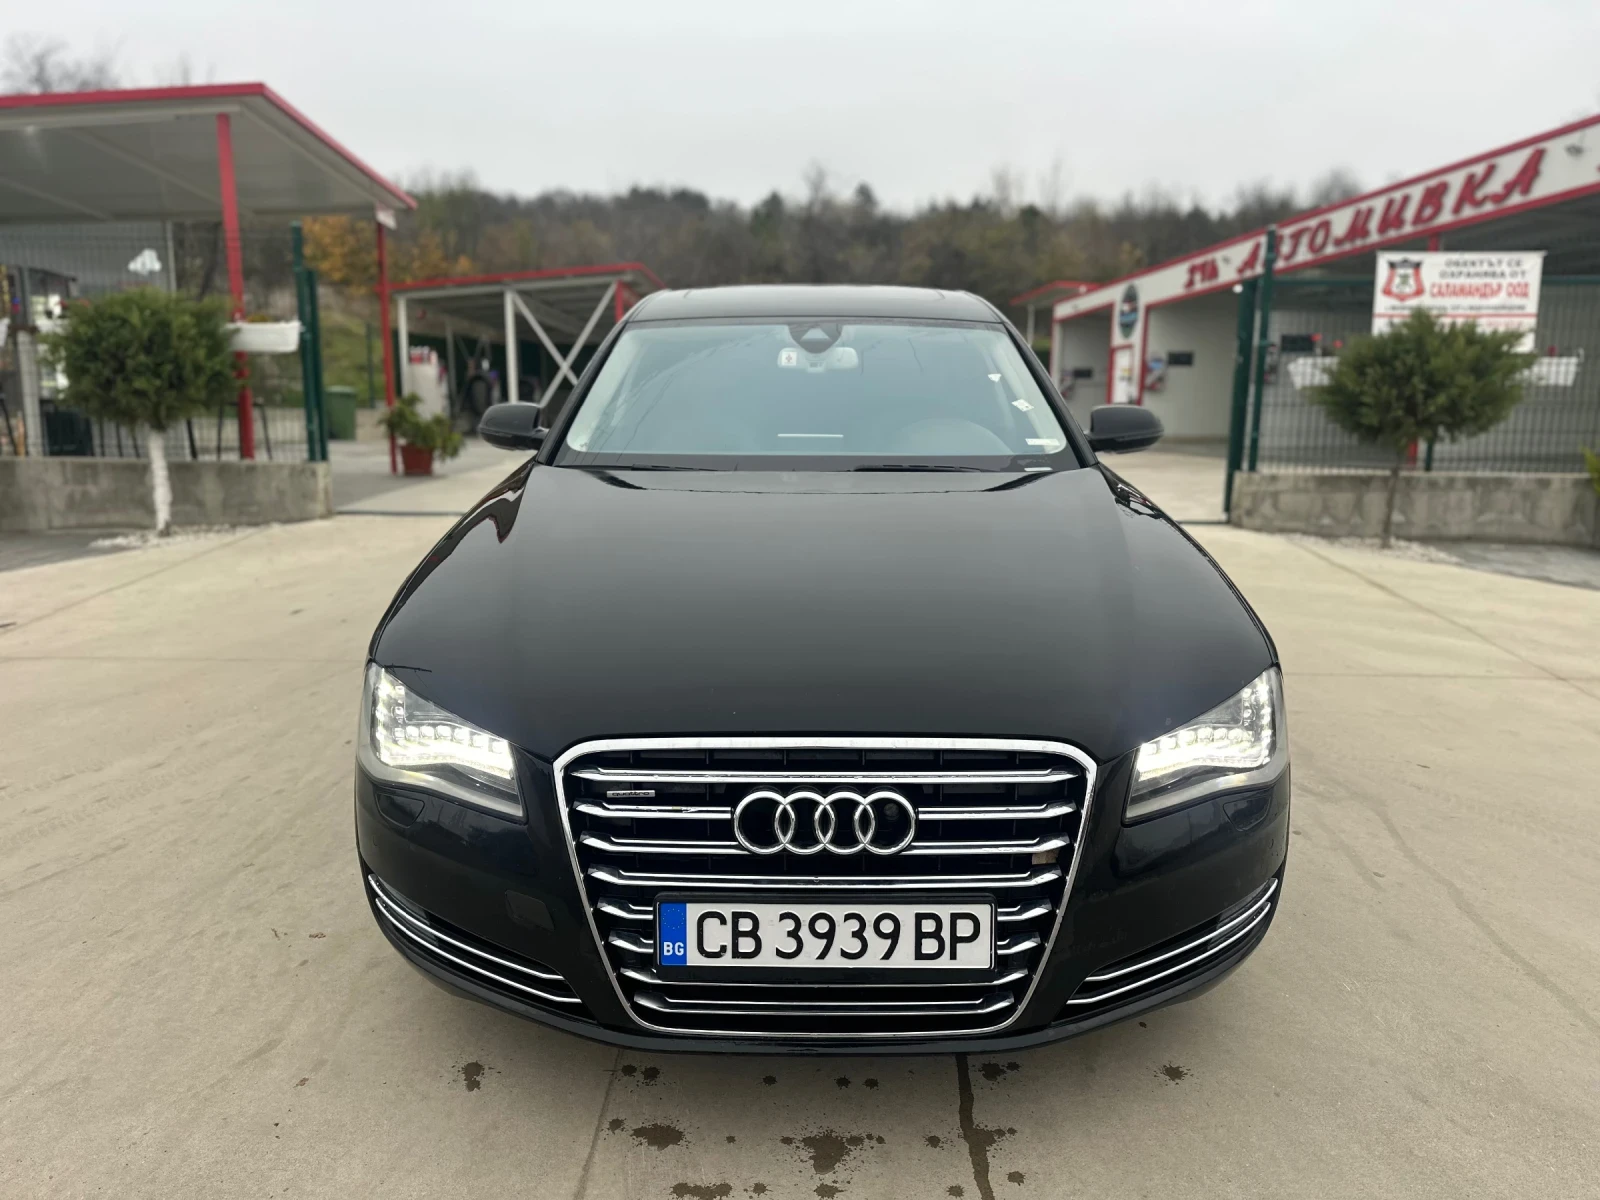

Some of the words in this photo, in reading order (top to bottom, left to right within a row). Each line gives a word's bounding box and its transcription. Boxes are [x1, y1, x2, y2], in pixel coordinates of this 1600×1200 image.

[663, 942, 685, 956] BG
[697, 911, 762, 959] CB
[775, 912, 901, 960] 3939
[914, 912, 981, 960] BP
